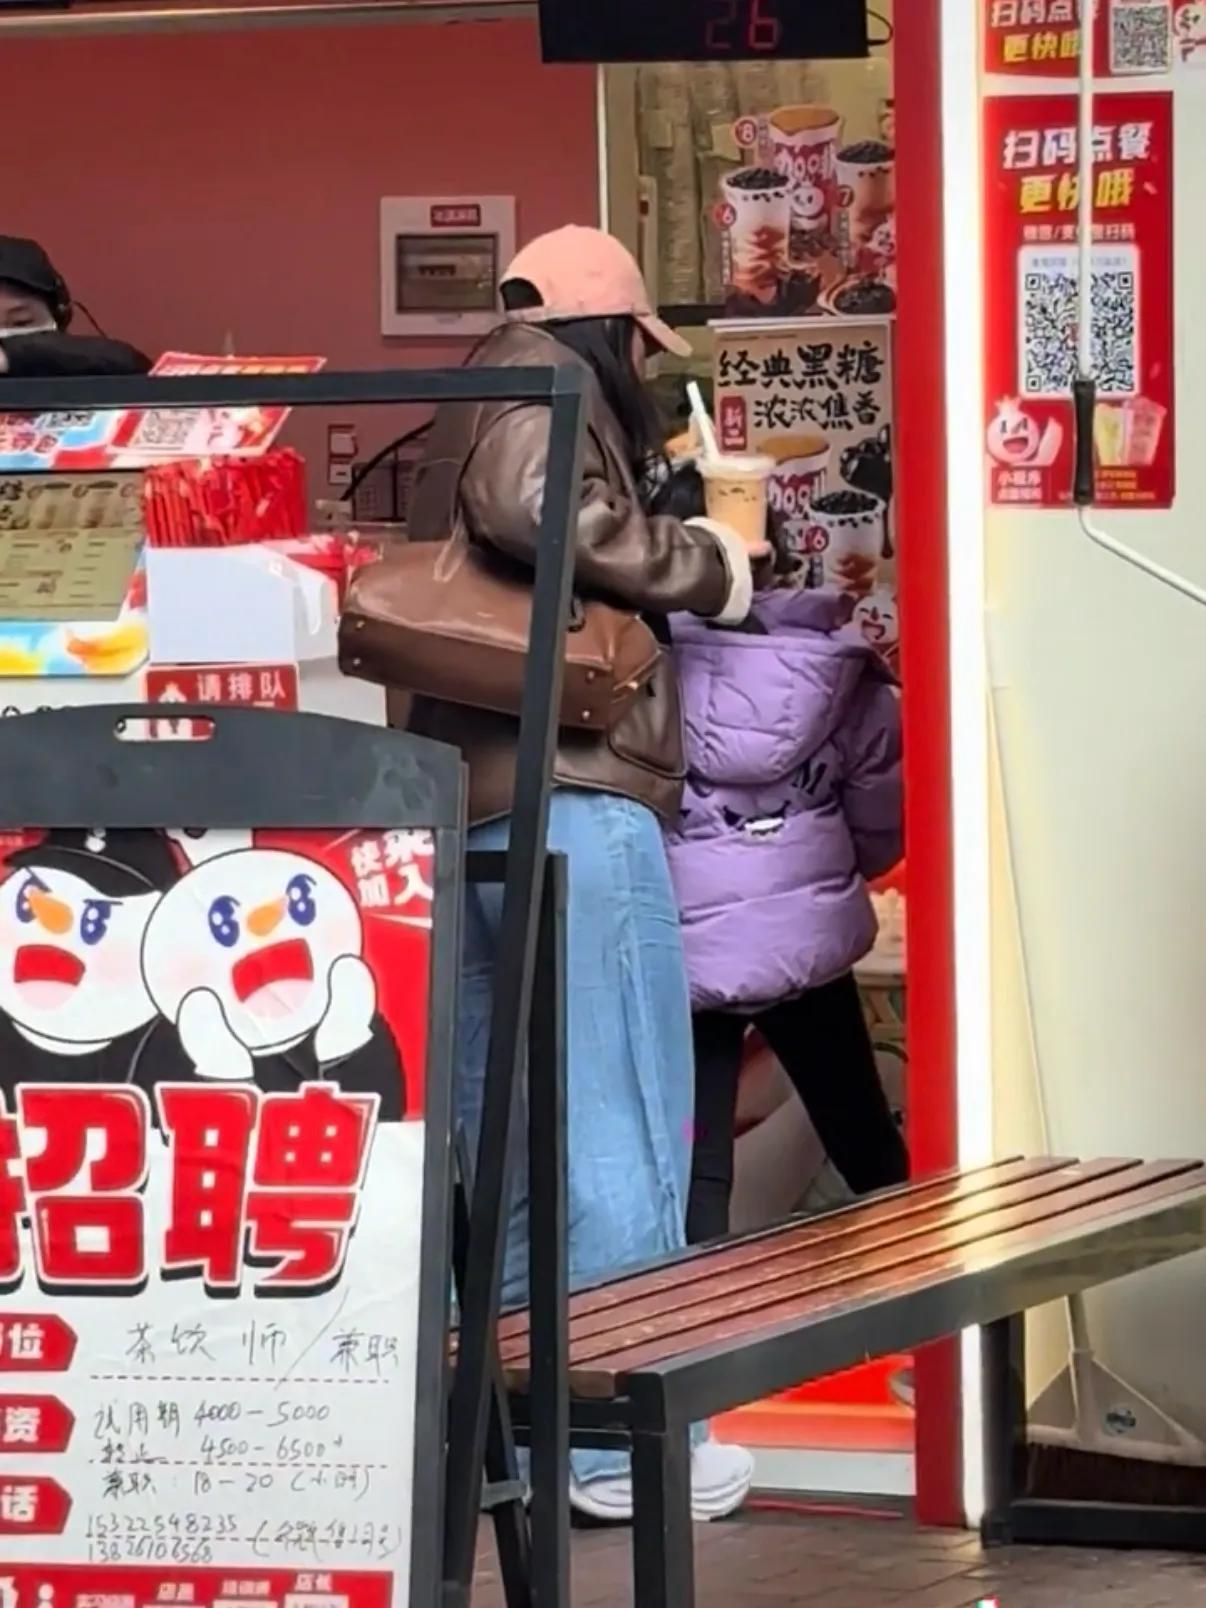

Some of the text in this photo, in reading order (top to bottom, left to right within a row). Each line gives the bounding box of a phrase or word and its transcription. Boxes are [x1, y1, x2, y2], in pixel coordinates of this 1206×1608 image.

[1002, 121, 1153, 169] 扫码点餐
[1020, 168, 1135, 214] 更快哦
[717, 340, 884, 390] 经典黑糖
[753, 391, 881, 430] 浓浓焦香
[197, 671, 287, 701] 请排队
[0, 1081, 381, 1299] 招聘
[0, 1322, 44, 1359] 位
